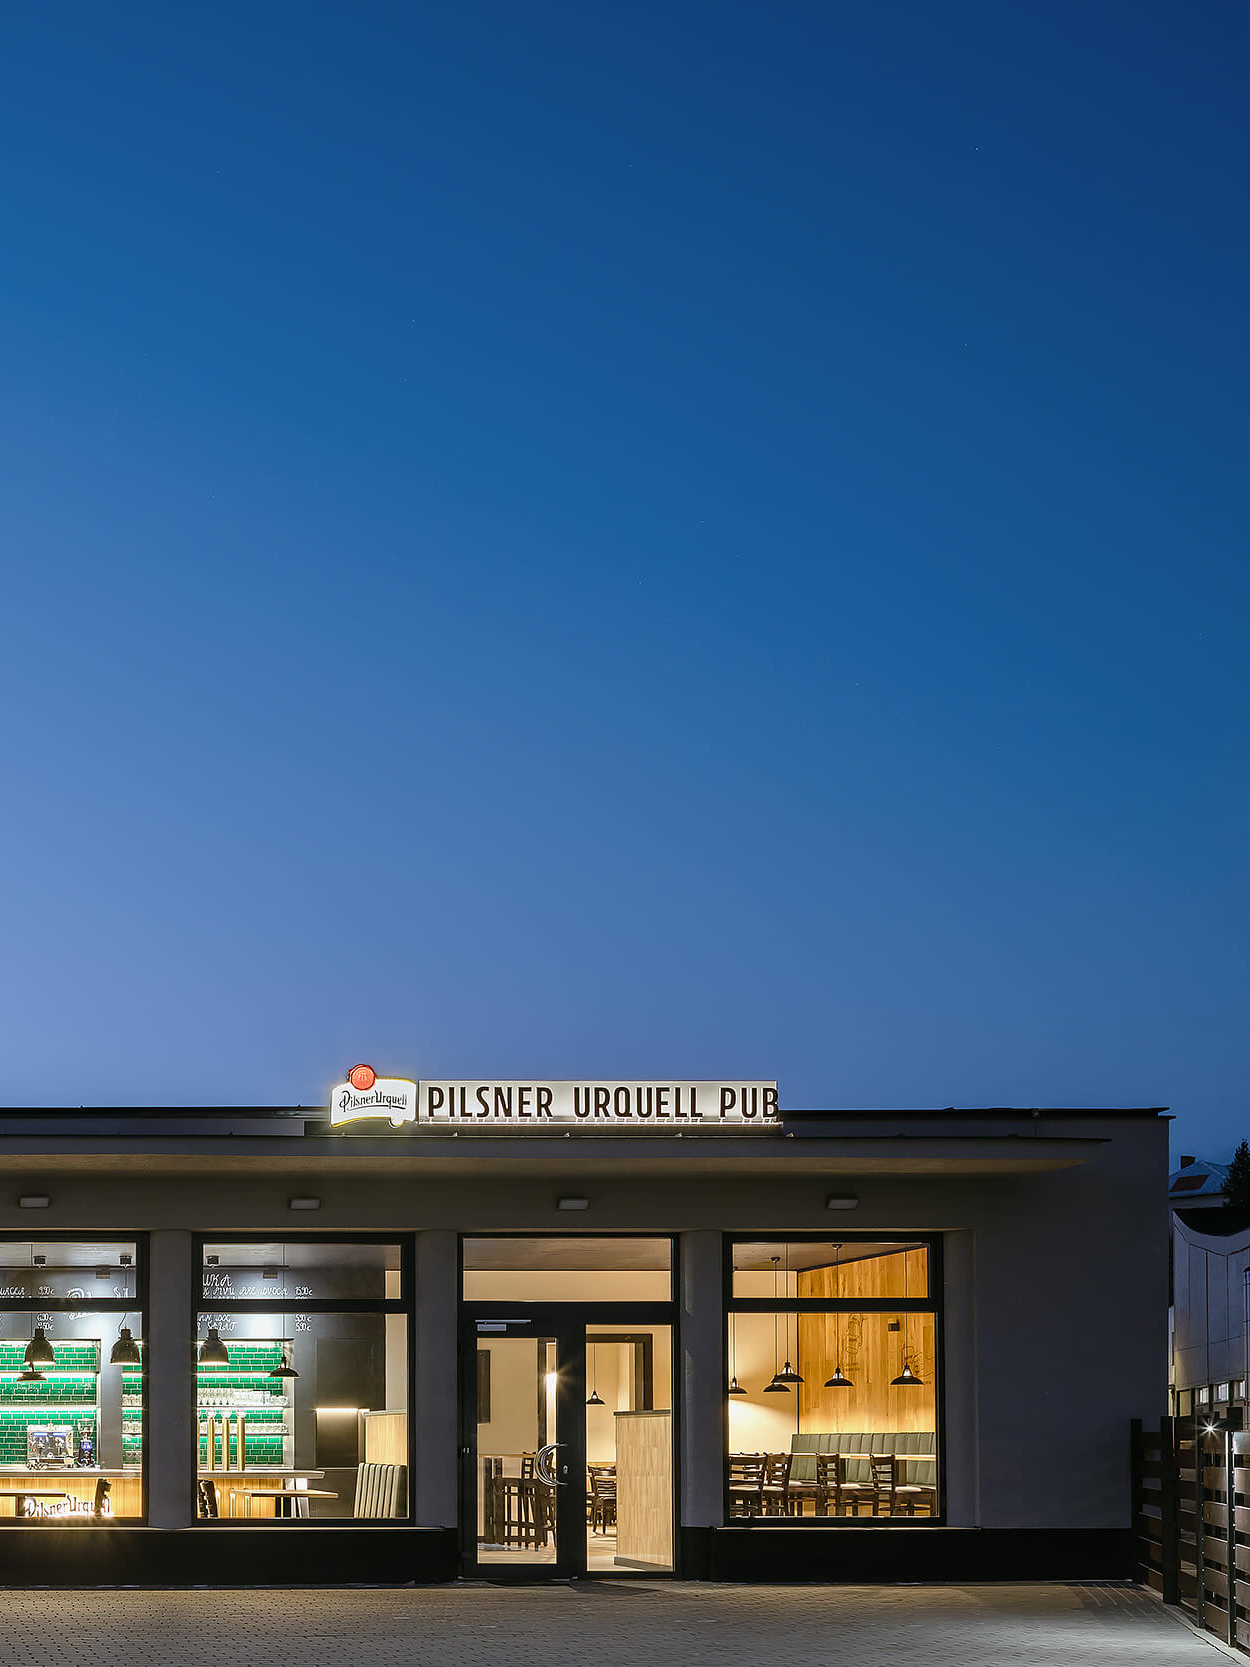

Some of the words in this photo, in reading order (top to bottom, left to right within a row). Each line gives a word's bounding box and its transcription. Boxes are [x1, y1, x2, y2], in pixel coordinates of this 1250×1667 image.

[339, 1090, 376, 1112] Pilsner
[375, 1090, 407, 1109] Urquell
[428, 1086, 553, 1118] PILSNER
[573, 1086, 703, 1118] URQUELL
[719, 1086, 779, 1118] PUB
